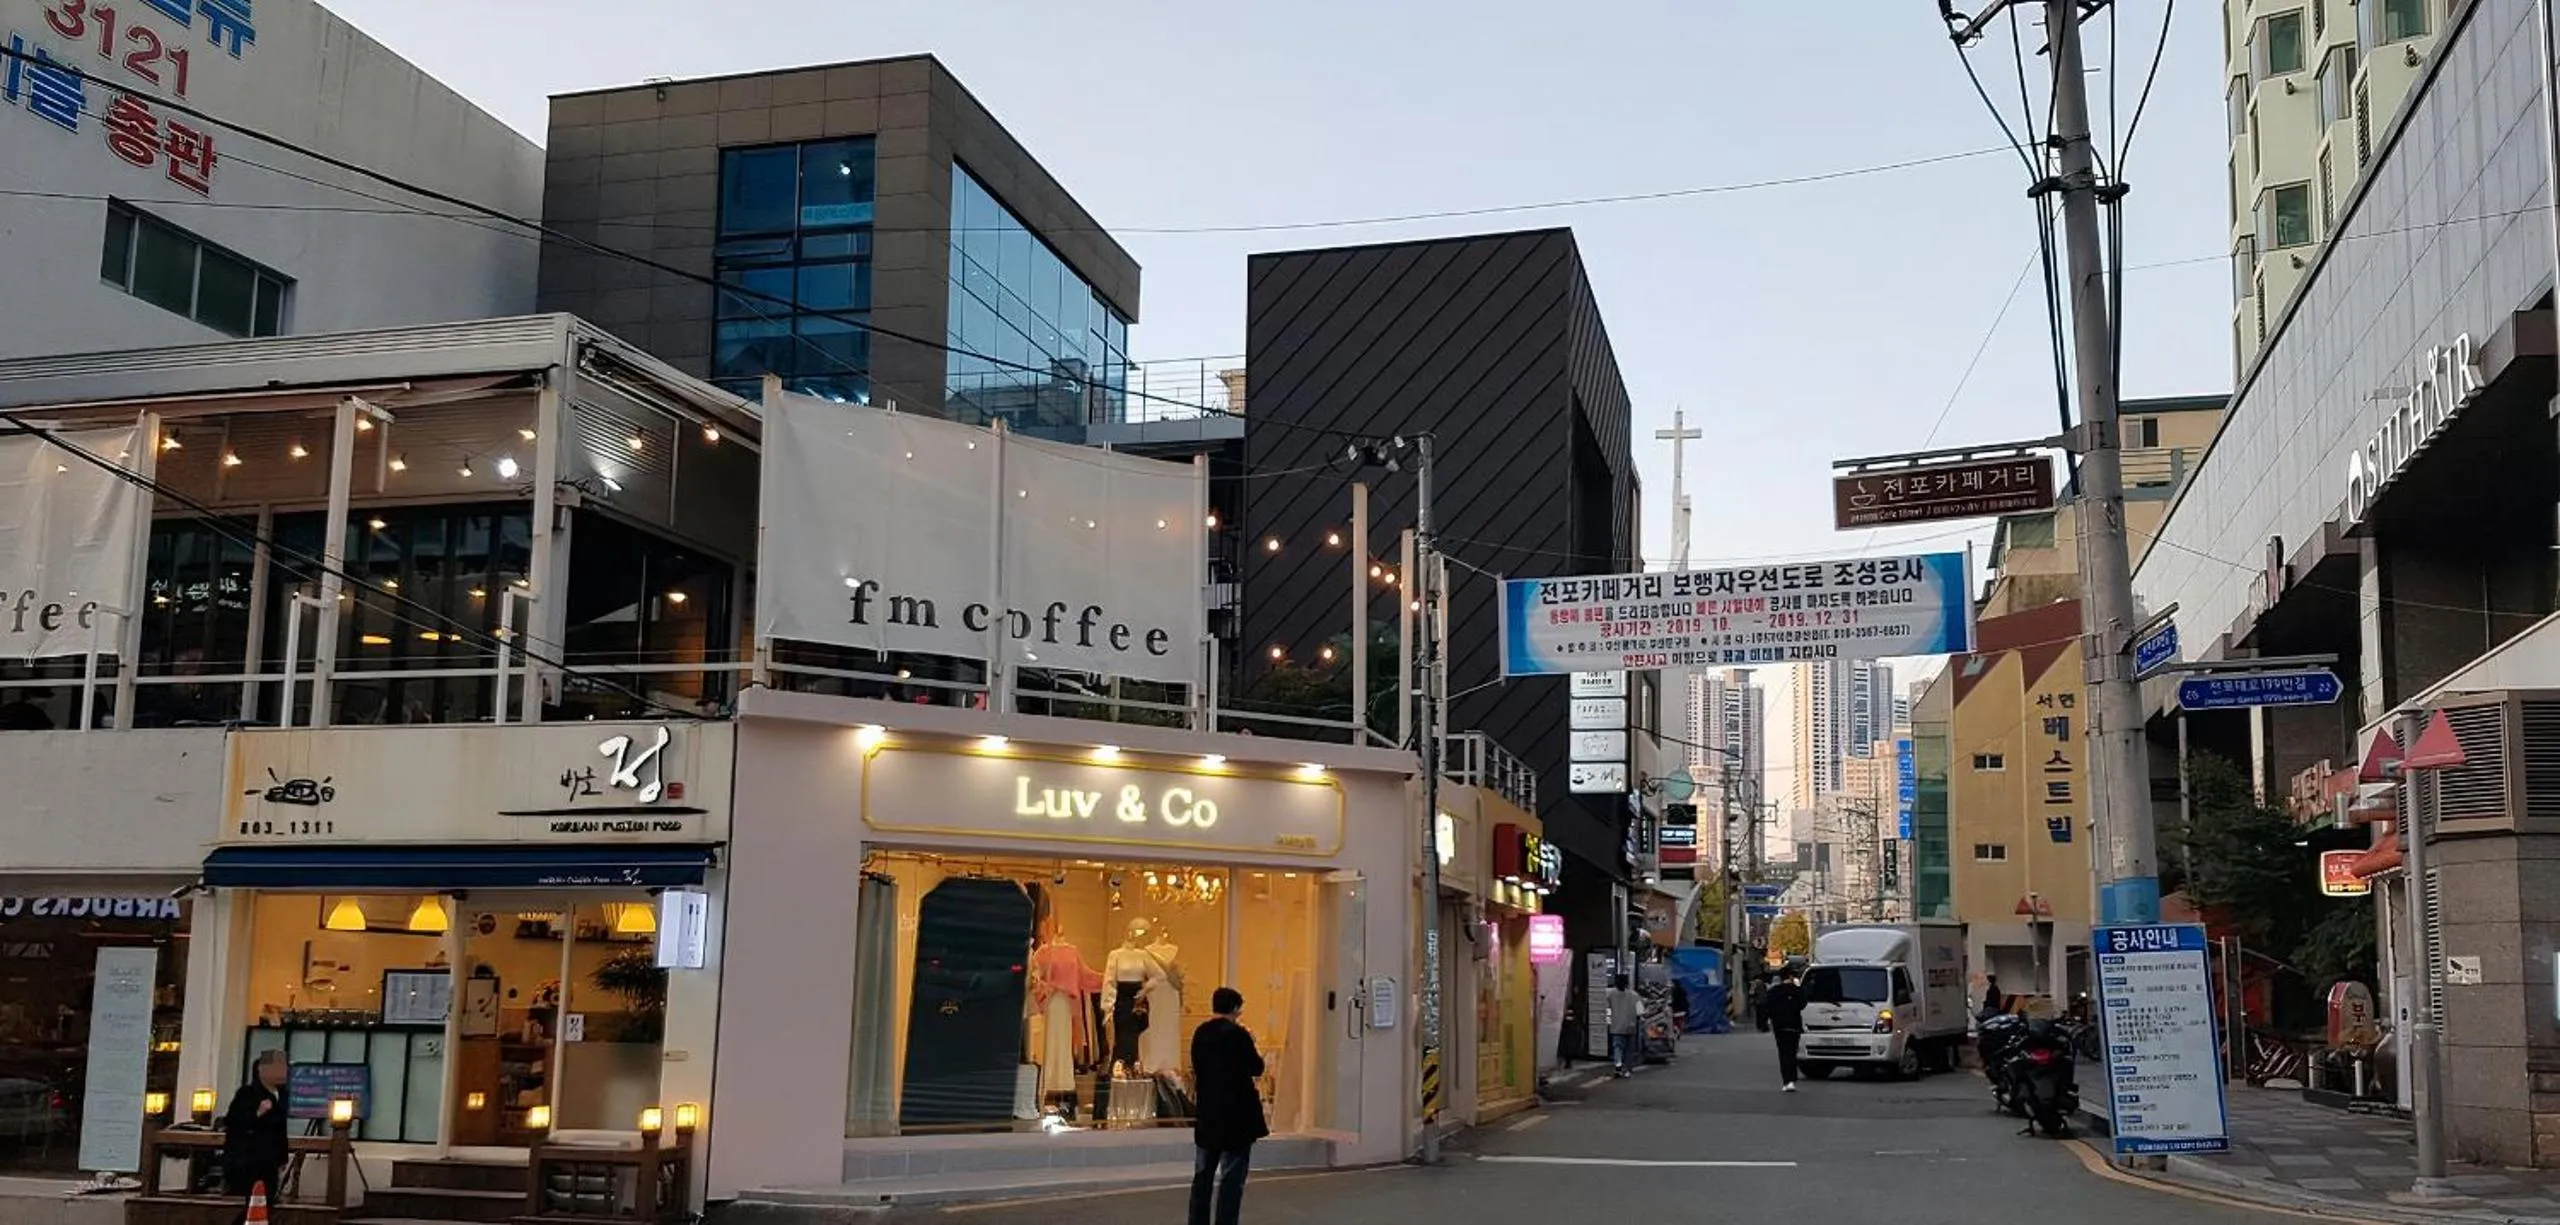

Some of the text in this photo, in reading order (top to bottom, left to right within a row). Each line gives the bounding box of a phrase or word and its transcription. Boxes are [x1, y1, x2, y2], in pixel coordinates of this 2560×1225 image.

[103, 91, 219, 199] 총판
[1883, 465, 2036, 501] 전포카페거리
[1540, 557, 1924, 605] 전포카페거리 보행자우선도로 조성공사
[0, 589, 98, 633] fee
[1770, 594, 1802, 611] 공사를
[1856, 588, 1913, 605] 하겠습니다
[848, 580, 1169, 656] fm coffee
[1601, 620, 1652, 637] 공사기간
[1843, 609, 1859, 624] 31
[1623, 653, 1667, 668] 안전사고
[2043, 716, 2073, 843] 베스트빌
[1015, 776, 1219, 828] Luv & Co
[241, 821, 333, 835] 803_1311
[551, 820, 599, 833] KOREAN
[653, 820, 683, 832] FOOD
[2112, 927, 2179, 951] 공사안내
